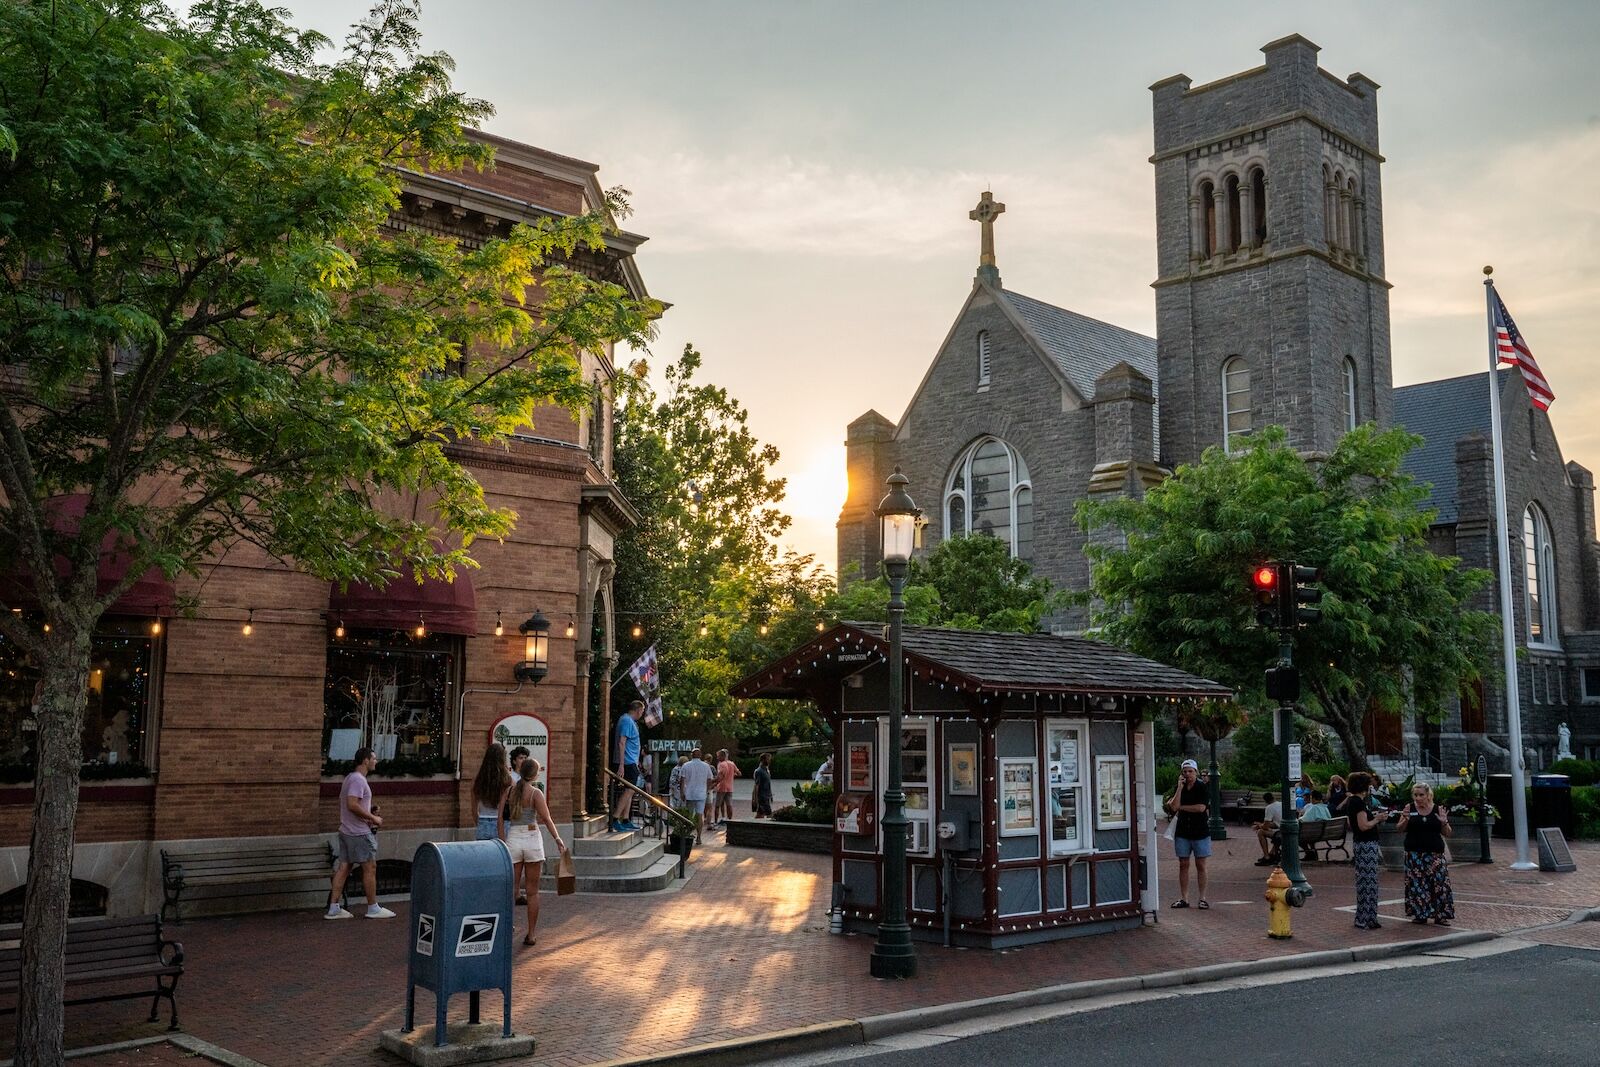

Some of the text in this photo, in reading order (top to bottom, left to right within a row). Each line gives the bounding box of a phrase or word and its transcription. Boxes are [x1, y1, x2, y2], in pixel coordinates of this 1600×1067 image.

[838, 654, 867, 662] INFORMATION
[507, 735, 547, 746] WINTERWOOD
[651, 739, 698, 752] CAPE MAY
